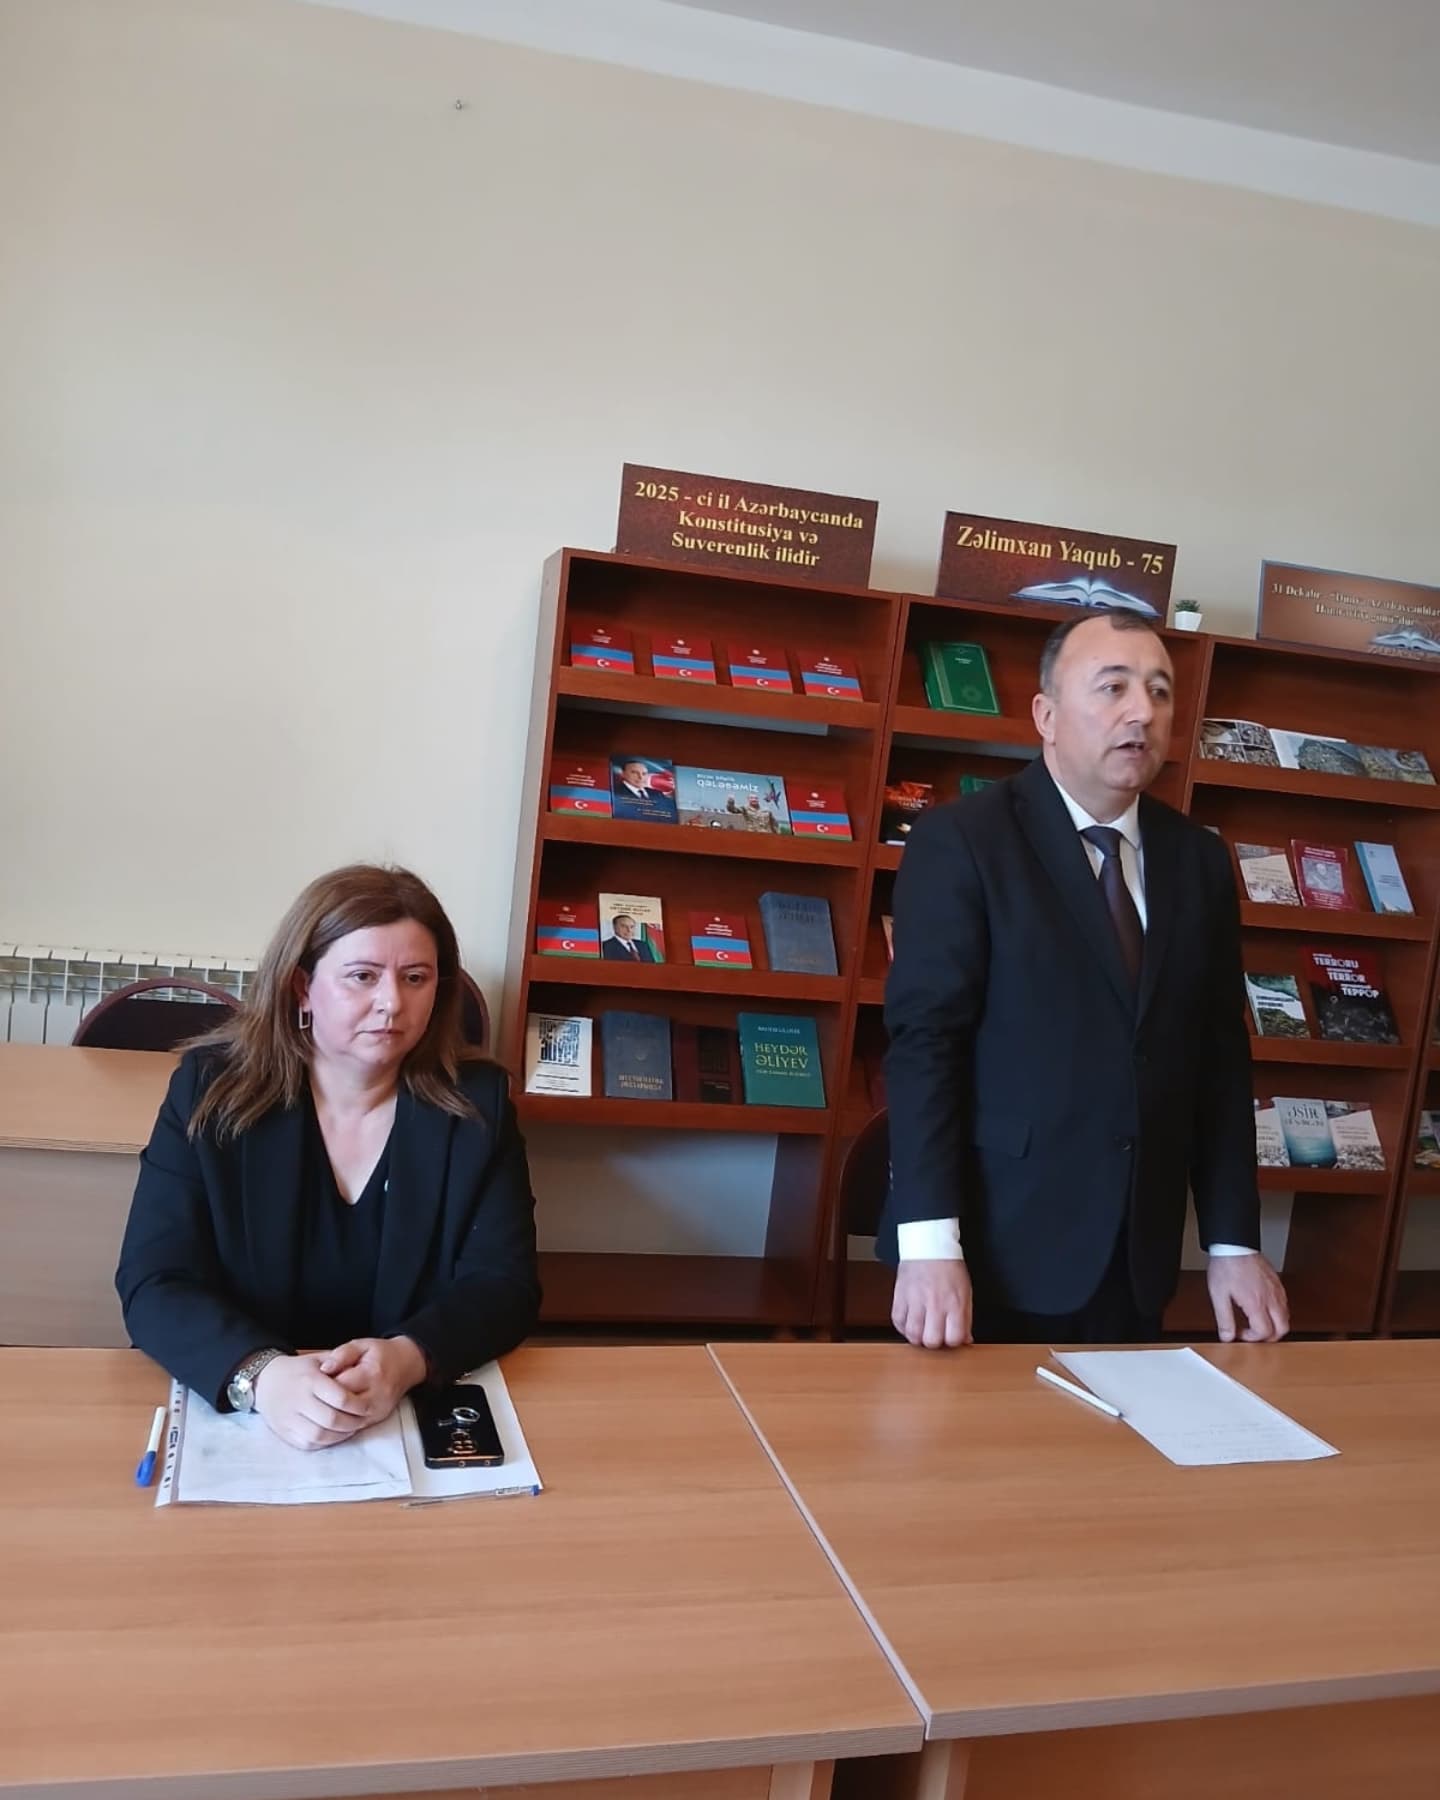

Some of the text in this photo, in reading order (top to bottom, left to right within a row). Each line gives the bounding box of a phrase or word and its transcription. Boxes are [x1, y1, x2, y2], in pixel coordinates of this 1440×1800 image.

[634, 481, 679, 501] 2025
[696, 491, 713, 508] ci
[718, 493, 730, 509] il
[734, 496, 864, 529] Azərbaycanda
[678, 510, 818, 545] Konstitusiya və
[671, 532, 821, 567] Suverenlik ilidir
[956, 525, 1052, 558] Zəlimxan
[1059, 540, 1121, 571] Yaqub
[1141, 553, 1164, 575] 75
[754, 1042, 808, 1057] HEYDƏR
